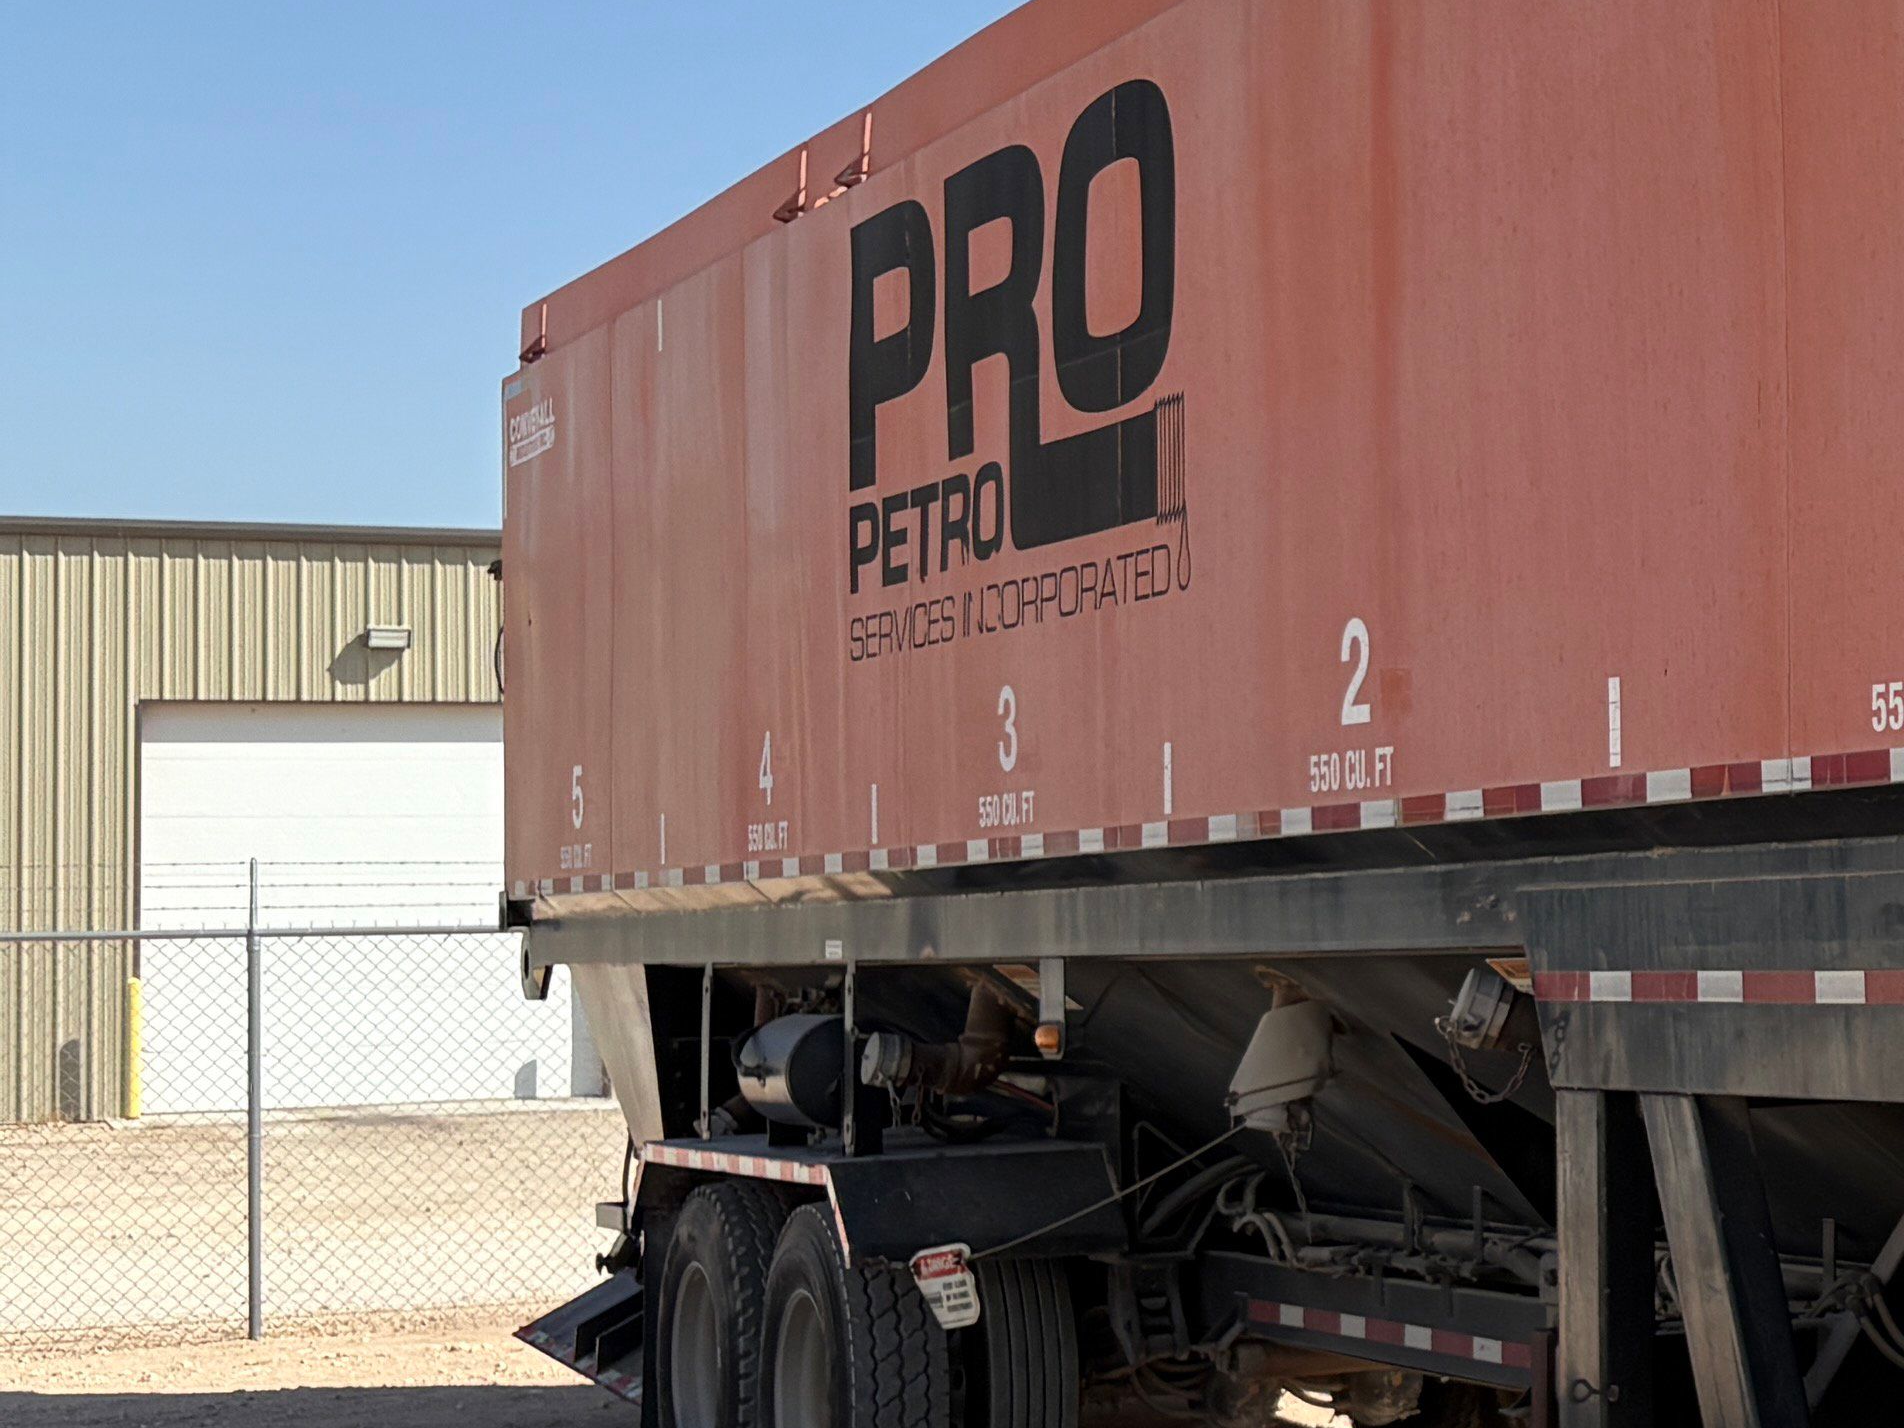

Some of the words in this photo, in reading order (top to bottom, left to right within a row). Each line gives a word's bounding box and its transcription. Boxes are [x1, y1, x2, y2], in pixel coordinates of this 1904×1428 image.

[850, 79, 1176, 550] PRO
[850, 461, 1005, 594] PETRO
[850, 595, 955, 662] SERVICES
[1341, 617, 1371, 726] 2
[998, 685, 1018, 772] 3
[572, 764, 584, 830] 5
[759, 730, 773, 806] 4
[1310, 752, 1340, 793] 550
[1345, 749, 1371, 790] CU.
[1375, 746, 1395, 787] FT
[979, 795, 1000, 828] 550
[1002, 792, 1020, 827] CU.
[1022, 790, 1035, 824] FT
